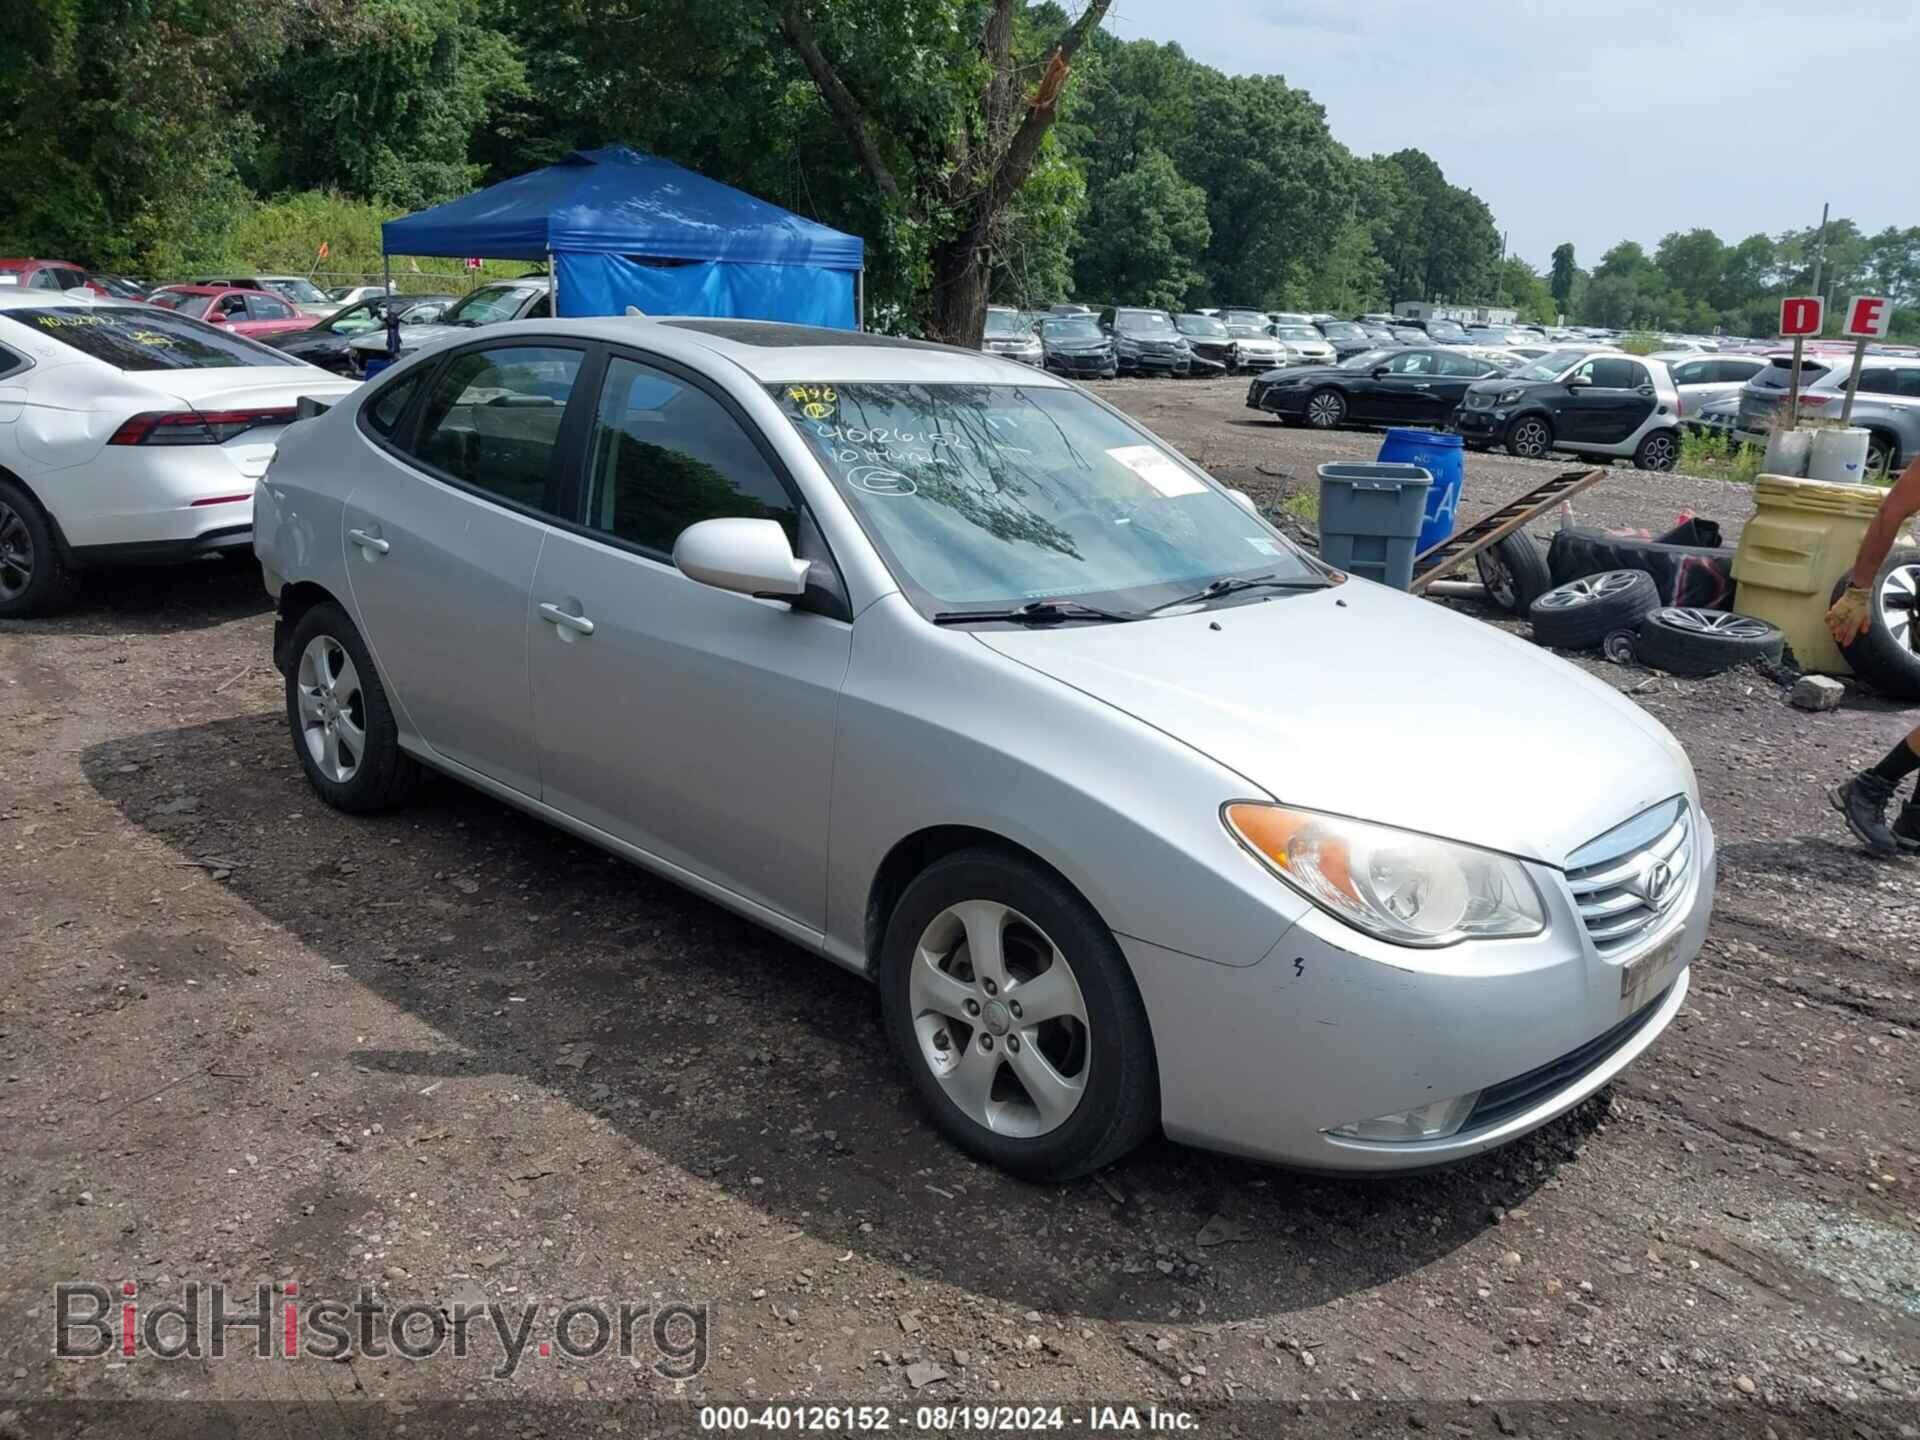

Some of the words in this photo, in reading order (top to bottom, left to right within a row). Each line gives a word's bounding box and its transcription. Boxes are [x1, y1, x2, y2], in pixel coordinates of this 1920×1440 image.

[1782, 299, 1820, 334] D
[1851, 299, 1884, 335] E
[817, 425, 971, 450] 40126152
[831, 447, 858, 463] 10
